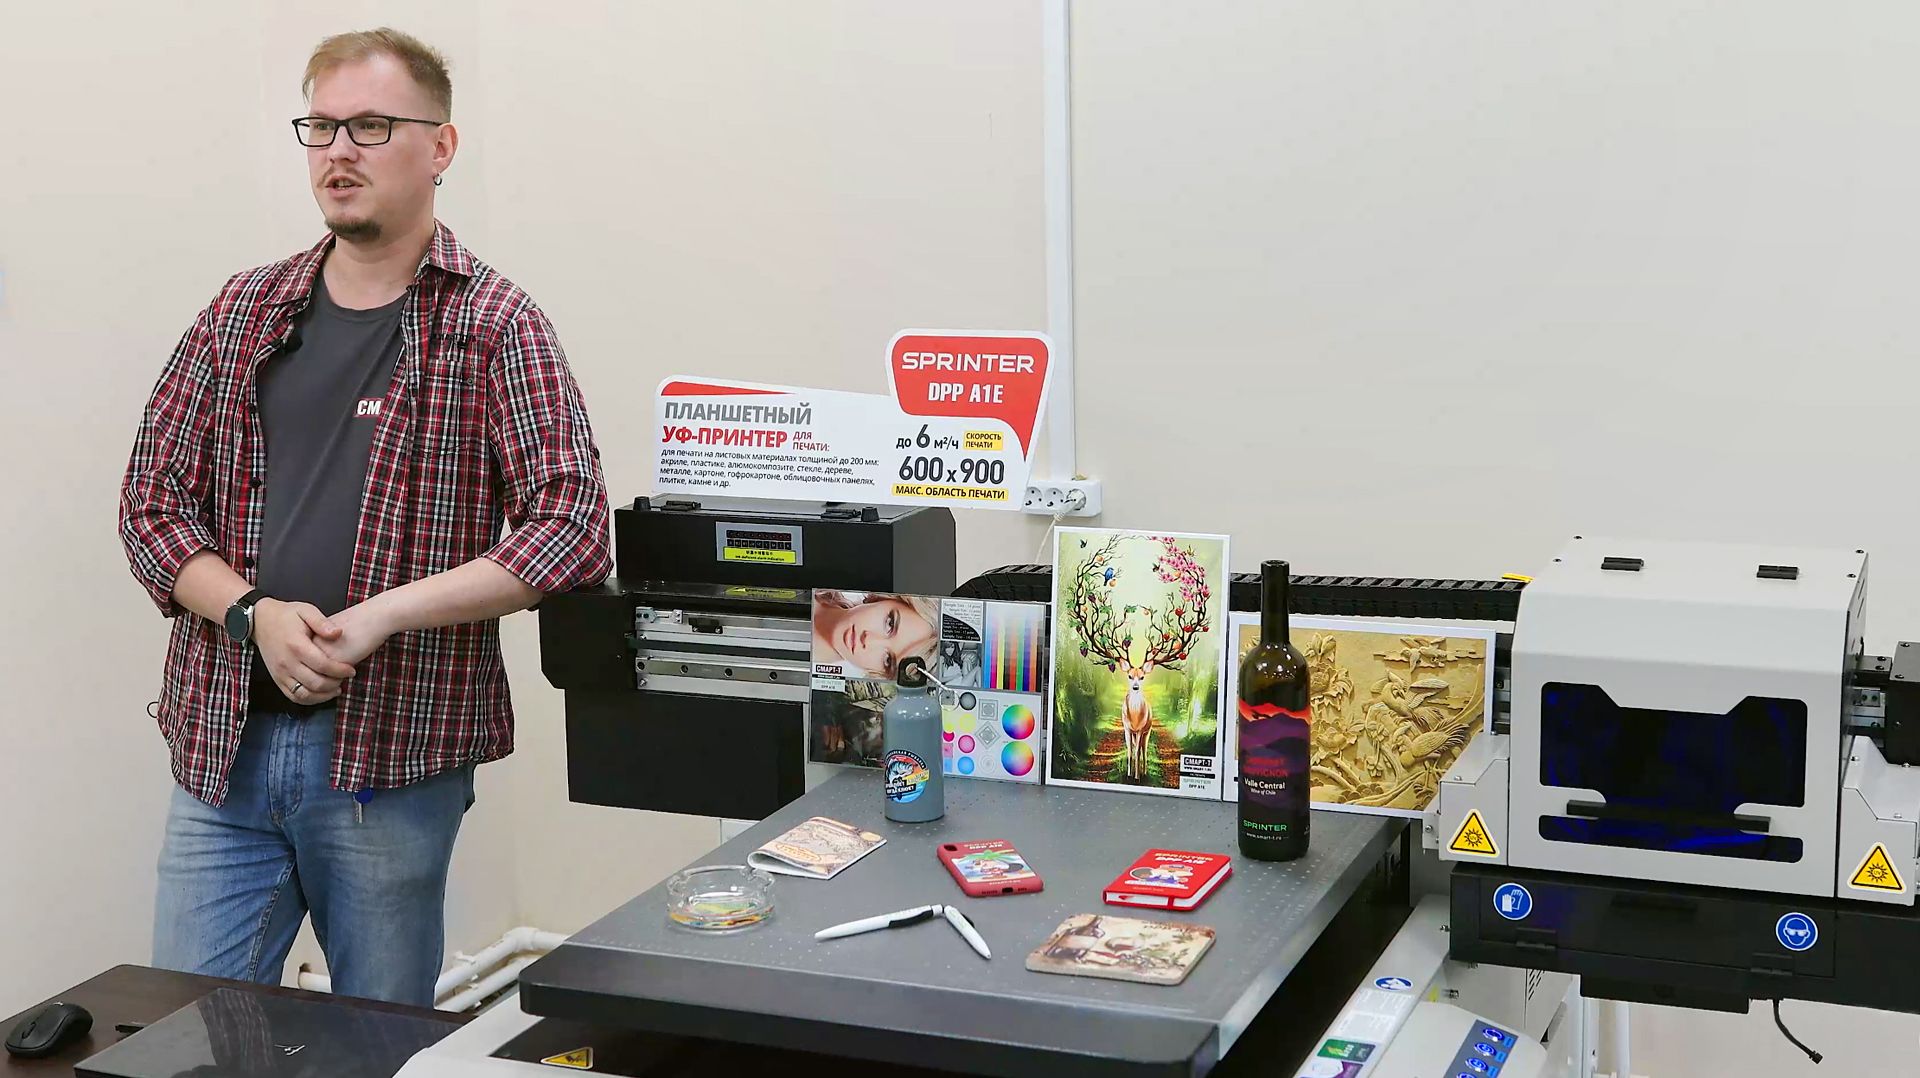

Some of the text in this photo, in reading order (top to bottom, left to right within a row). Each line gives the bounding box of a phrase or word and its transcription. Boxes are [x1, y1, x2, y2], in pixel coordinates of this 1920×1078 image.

[902, 351, 1035, 373] SPRINTER
[928, 382, 1004, 403] DPP A1E
[664, 402, 812, 425] ПЛАНШЕТНЫЙ
[662, 425, 788, 448] УФ-ПРИНТЕР
[792, 431, 812, 441] ДЛЯ
[896, 437, 912, 449] до
[916, 424, 931, 448] 6
[965, 432, 1002, 441] СКОРОСТЬ
[792, 441, 830, 452] ПЕЧАТИ:
[965, 440, 993, 449] ПЕЧАТИ
[661, 449, 676, 457] для
[676, 449, 703, 458] печати
[715, 452, 751, 460] листовых
[752, 454, 797, 463] материалах
[799, 456, 838, 465] толщиной
[850, 457, 864, 465] 200
[661, 458, 854, 476] акриле, пластике, алюмокомпозите, стекле, дереве,
[899, 456, 943, 482] 600
[960, 458, 1005, 485] 900
[659, 476, 687, 485] плитке,
[688, 478, 712, 486] камне
[719, 480, 731, 488] др.
[660, 468, 875, 486] металле, картоне, гофрокартоне, облицовочных панелях,
[895, 485, 1005, 499] МАКС. ОБЛАСТЬ ПЕЧАТИ
[1244, 777, 1286, 790] Valle Central
[1243, 819, 1288, 832] SPRINTER
